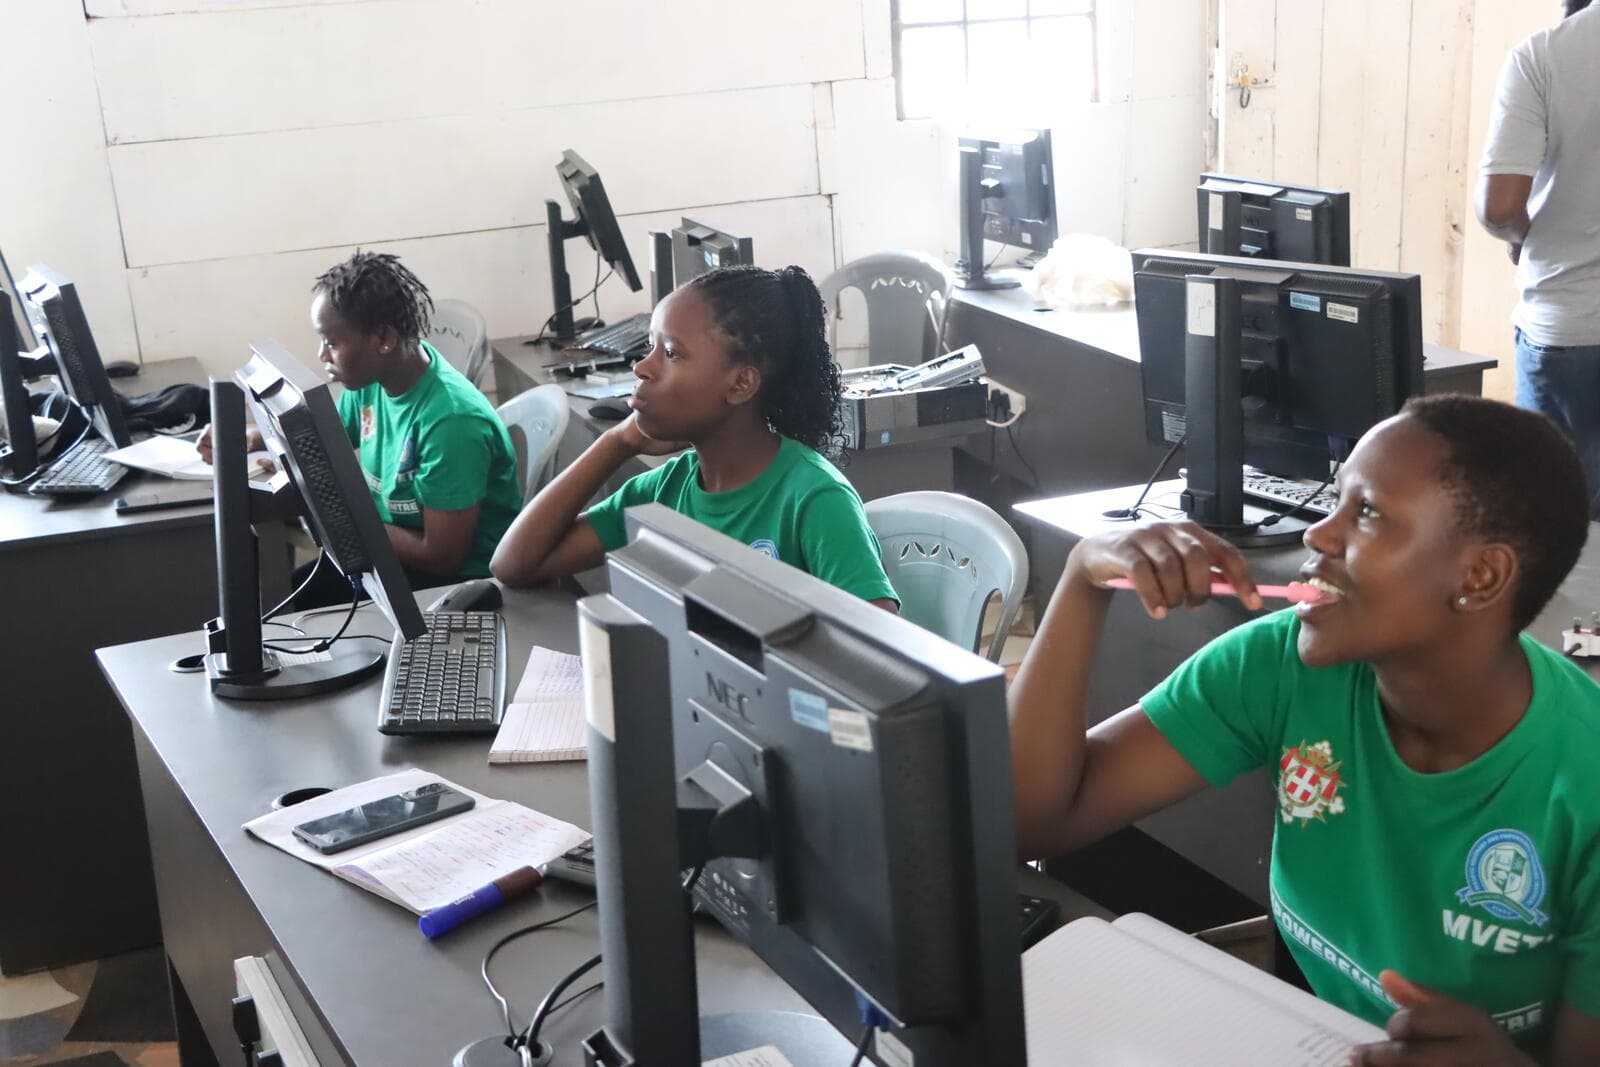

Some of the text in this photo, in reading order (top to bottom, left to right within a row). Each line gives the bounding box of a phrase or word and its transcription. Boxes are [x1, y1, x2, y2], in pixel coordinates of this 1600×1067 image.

[706, 671, 756, 726] NEC
[1270, 894, 1392, 1004] POWEREME
[1442, 908, 1556, 955] MVET
